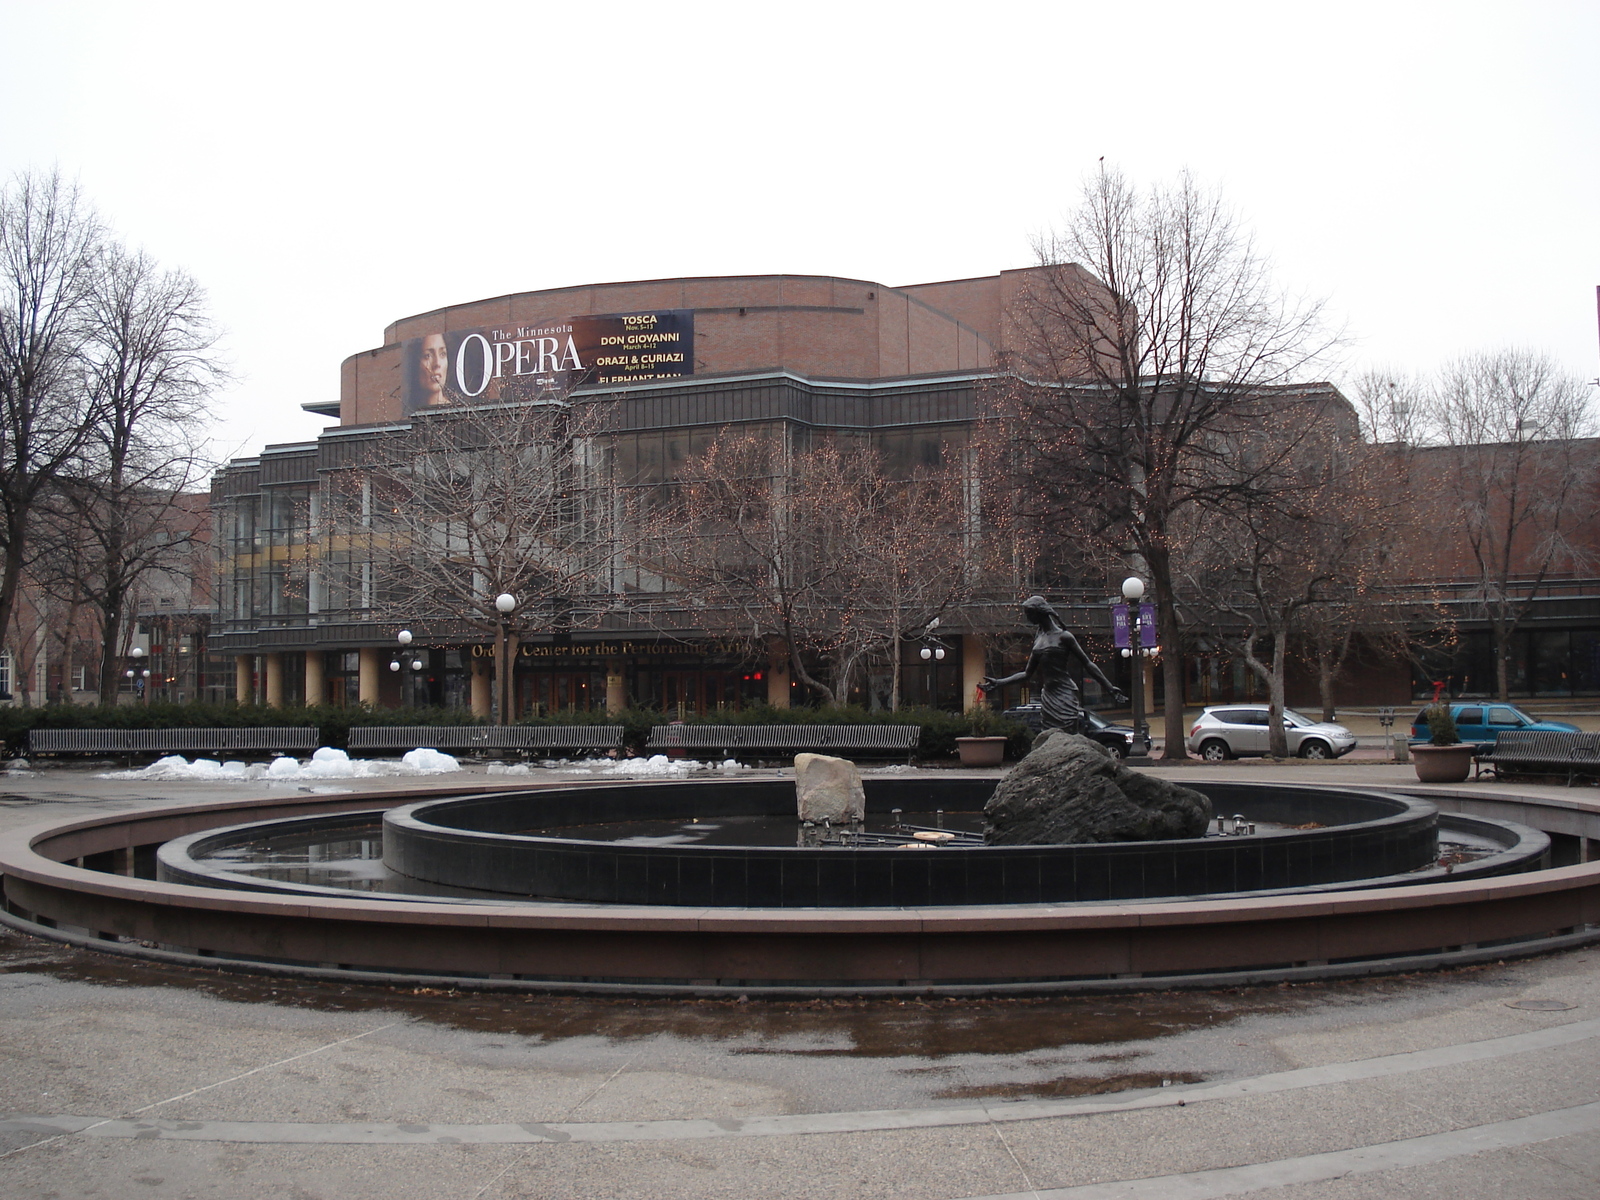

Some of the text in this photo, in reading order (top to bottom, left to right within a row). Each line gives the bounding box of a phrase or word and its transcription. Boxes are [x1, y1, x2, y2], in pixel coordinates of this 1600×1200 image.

[622, 315, 657, 325] TOSCA
[492, 324, 573, 340] The Minnesota
[601, 332, 680, 346] DON GIOVANNI
[456, 333, 586, 396] OPERA
[596, 353, 684, 366] ORAZI & CURIAZI
[600, 373, 654, 384] ELEPHANT
[522, 643, 568, 657] Center
[571, 643, 591, 656] for
[595, 641, 618, 655] the
[622, 641, 708, 655] Performing
